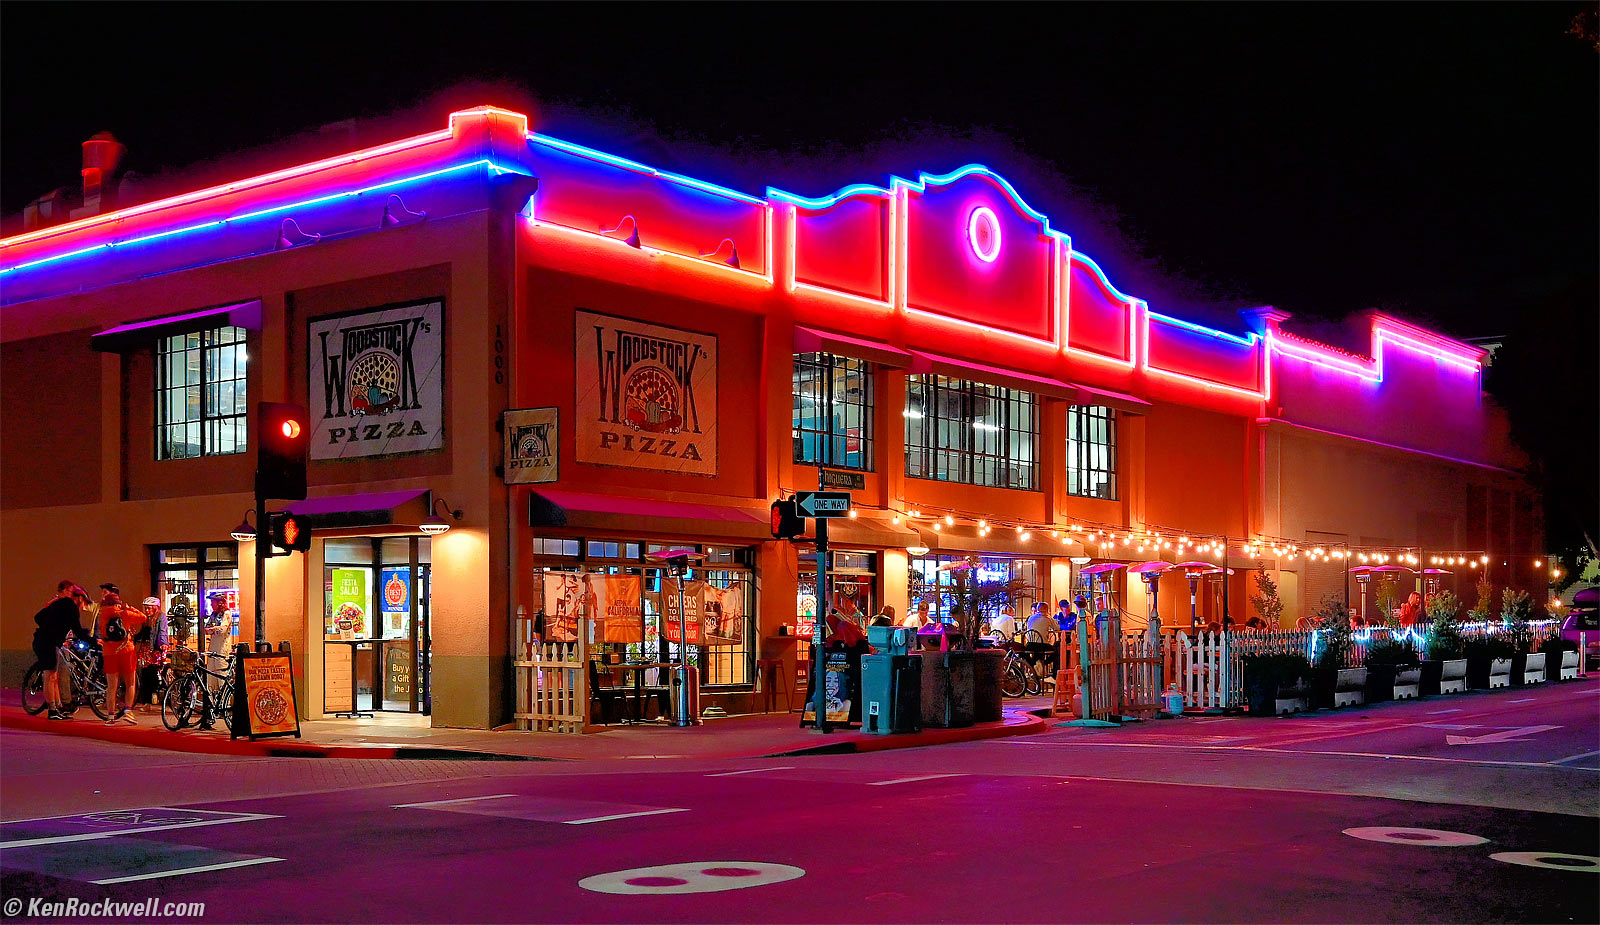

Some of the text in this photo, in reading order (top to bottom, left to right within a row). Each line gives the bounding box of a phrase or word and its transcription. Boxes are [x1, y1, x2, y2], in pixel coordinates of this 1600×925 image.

[495, 325, 504, 384] 1000
[328, 420, 427, 444] PIZZA
[600, 431, 702, 461] PIZZA
[510, 458, 551, 469] PIZZA
[814, 500, 845, 509] ONE WAY
[340, 587, 359, 595] SALAD
[668, 595, 697, 608] CHERS
[392, 664, 404, 673] Buy
[397, 675, 410, 683] Gift
[394, 684, 405, 693] the
